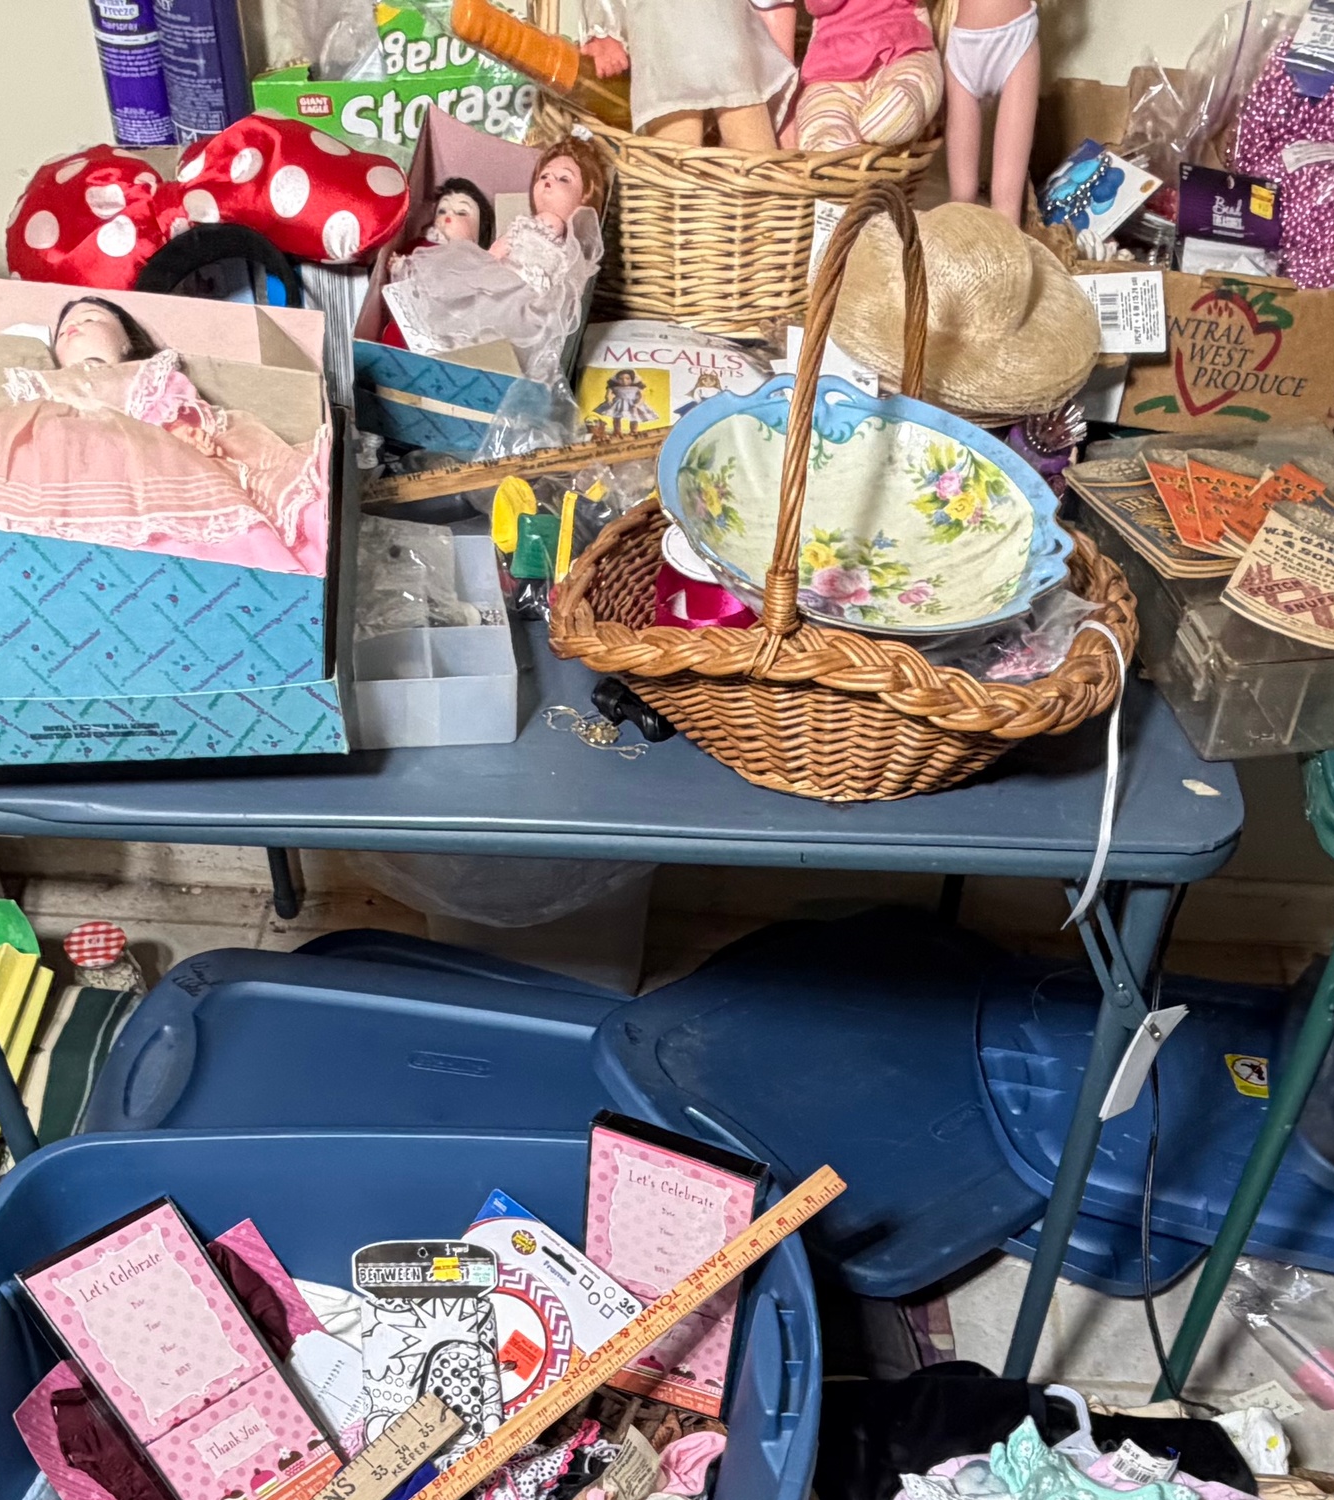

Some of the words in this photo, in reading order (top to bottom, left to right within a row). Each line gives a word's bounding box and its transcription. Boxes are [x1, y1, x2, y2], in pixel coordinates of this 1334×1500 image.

[299, 97, 329, 107] GIANT
[301, 104, 330, 115] EAGLE
[603, 345, 744, 371] McCALL'S
[1188, 343, 1255, 369] WEST
[1192, 368, 1309, 399] PRODUCE
[1247, 580, 1305, 596] SCOTCH
[628, 1168, 656, 1191] Let's
[660, 1179, 716, 1211] Celebrate
[78, 1279, 110, 1304] Let's
[108, 1250, 164, 1288] Celebrate
[359, 1266, 422, 1285] BETWEEN
[542, 1259, 571, 1287] Frames
[681, 1249, 728, 1289] PANEL
[618, 1297, 636, 1315] 36
[634, 1287, 682, 1327] TOWN
[617, 1326, 632, 1341] &
[560, 1340, 616, 1386] FLOORS
[207, 1435, 238, 1461] Thank
[233, 1421, 261, 1448] You
[369, 1464, 389, 1482] 33
[394, 1445, 410, 1462] 34
[417, 1422, 436, 1439] 35
[461, 1436, 497, 1467] (614)
[390, 1441, 431, 1478] KEEPER
[431, 1464, 461, 1491] 488
